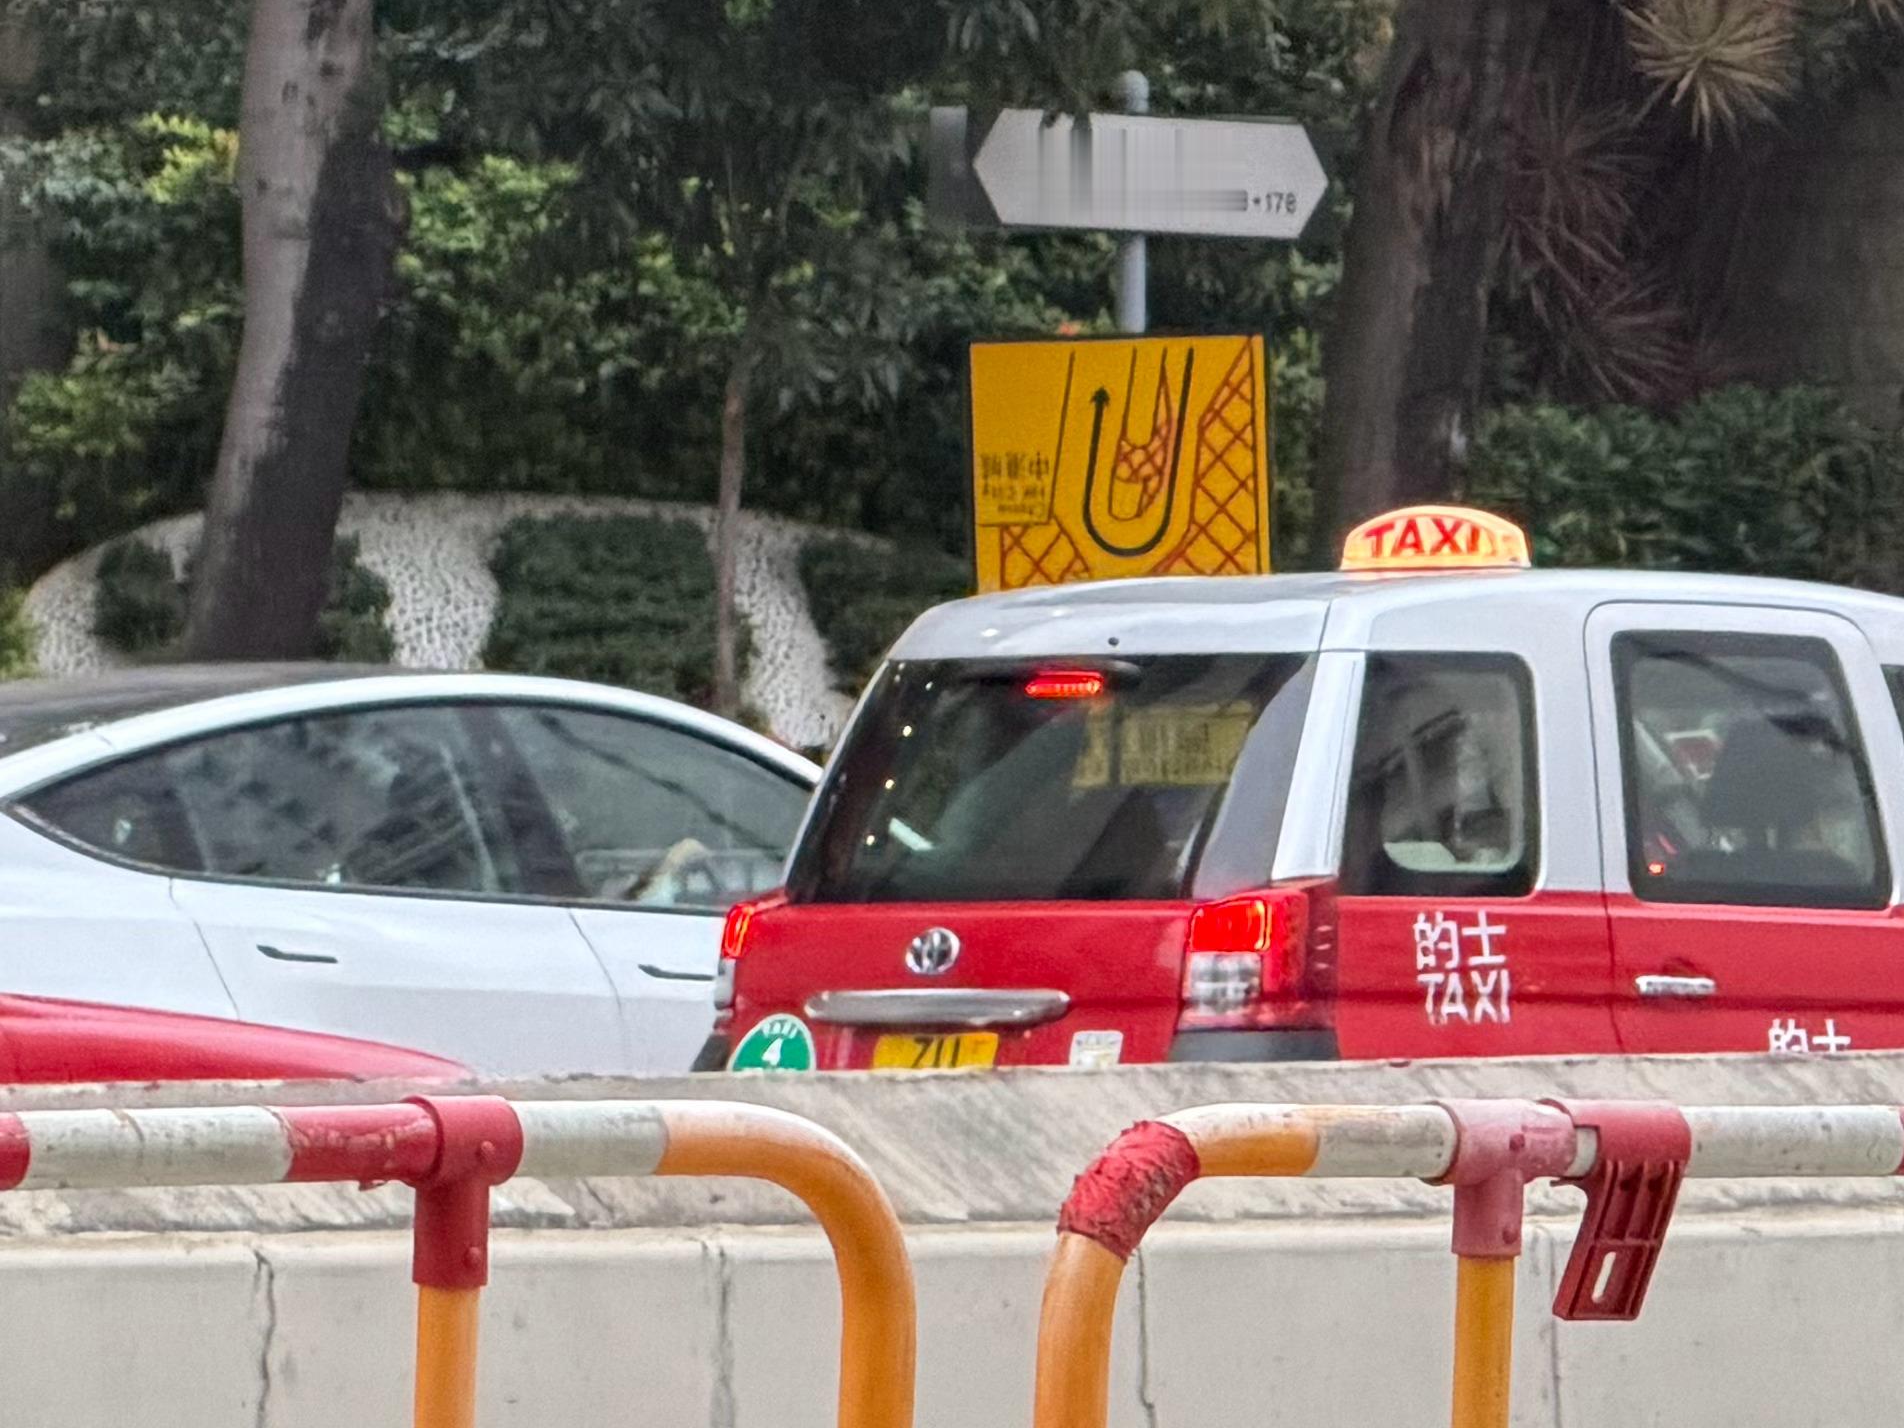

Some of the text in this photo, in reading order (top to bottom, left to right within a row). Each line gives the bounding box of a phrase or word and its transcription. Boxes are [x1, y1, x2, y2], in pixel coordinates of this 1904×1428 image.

[1364, 517, 1481, 559] TAXI
[1413, 910, 1507, 969] 的士
[1417, 969, 1510, 1024] TAXI
[761, 1037, 784, 1066] 4
